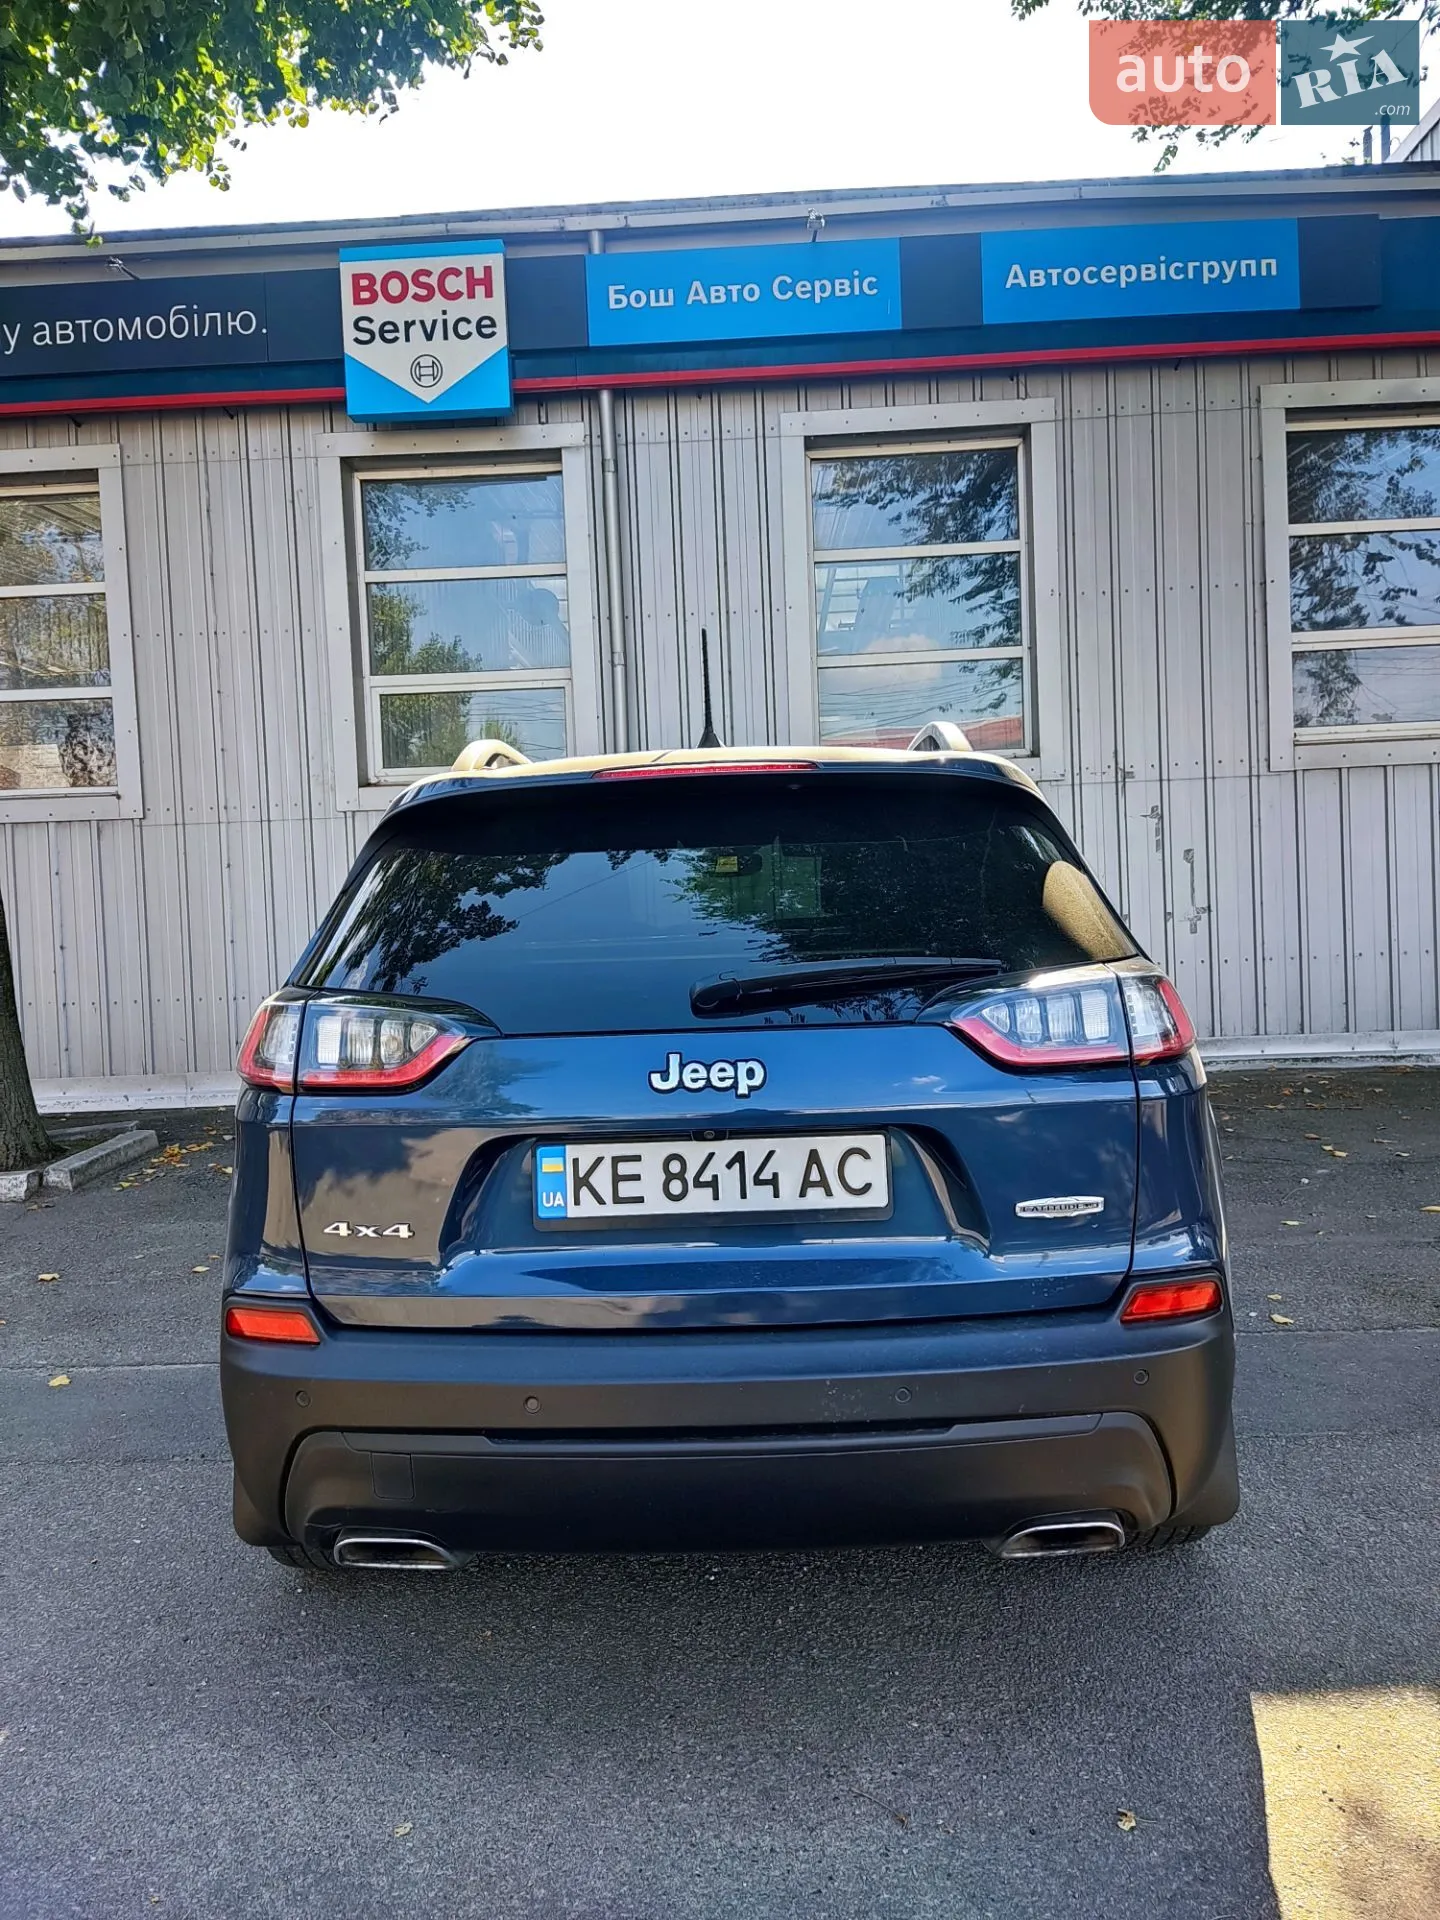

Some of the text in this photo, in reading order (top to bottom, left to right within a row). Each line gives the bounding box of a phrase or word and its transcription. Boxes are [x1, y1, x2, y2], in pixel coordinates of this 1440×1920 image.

[351, 265, 494, 305] BOSCH
[608, 270, 878, 310] Бош Авто Сервіс
[1005, 255, 1278, 289] Автосервісгрупп
[32, 305, 267, 346] автомобілю.
[352, 309, 498, 346] Service
[649, 1053, 766, 1097] Jeep
[571, 1147, 873, 1207] KE 8414 AC
[542, 1191, 565, 1208] UA
[323, 1220, 416, 1239] 4x4
